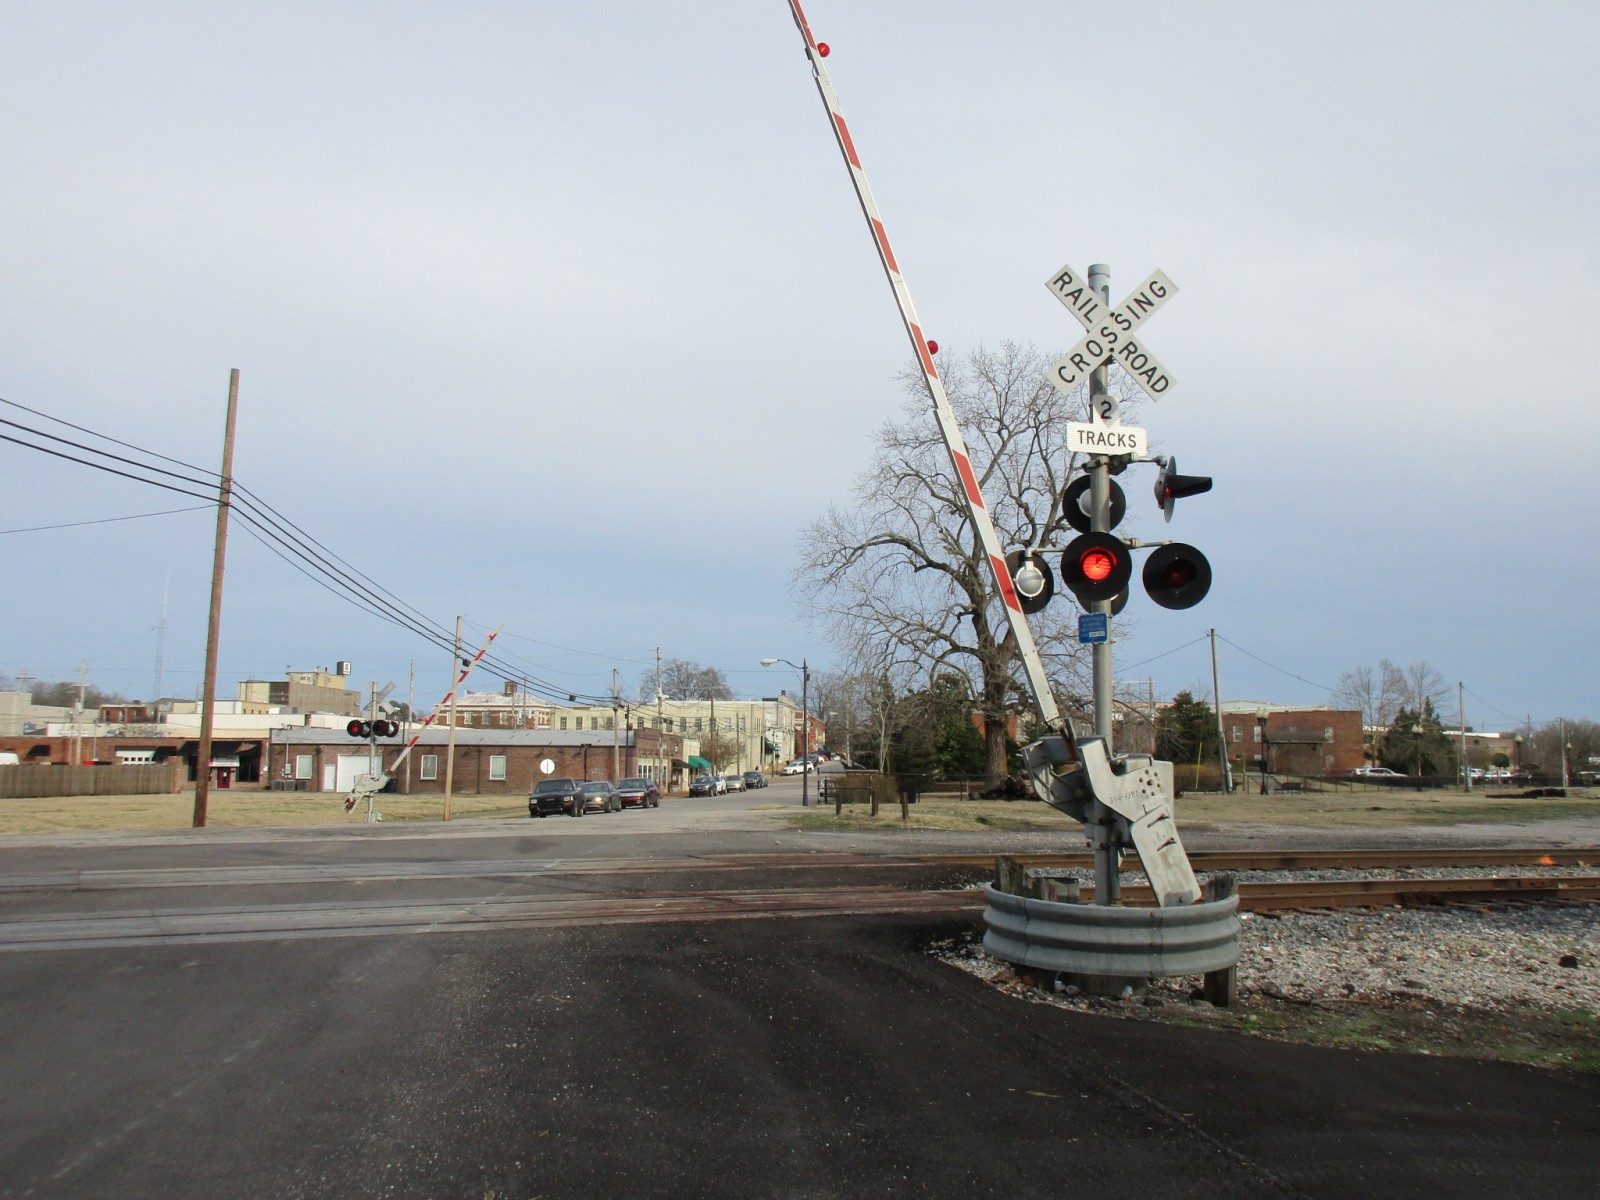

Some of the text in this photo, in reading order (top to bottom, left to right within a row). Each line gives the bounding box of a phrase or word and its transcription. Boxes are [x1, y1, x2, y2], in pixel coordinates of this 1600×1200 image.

[1053, 271, 1169, 393] RAIL ROAD
[1058, 281, 1167, 384] CROSSING
[1077, 430, 1137, 448] TRACKS
[1101, 401, 1112, 419] 2
